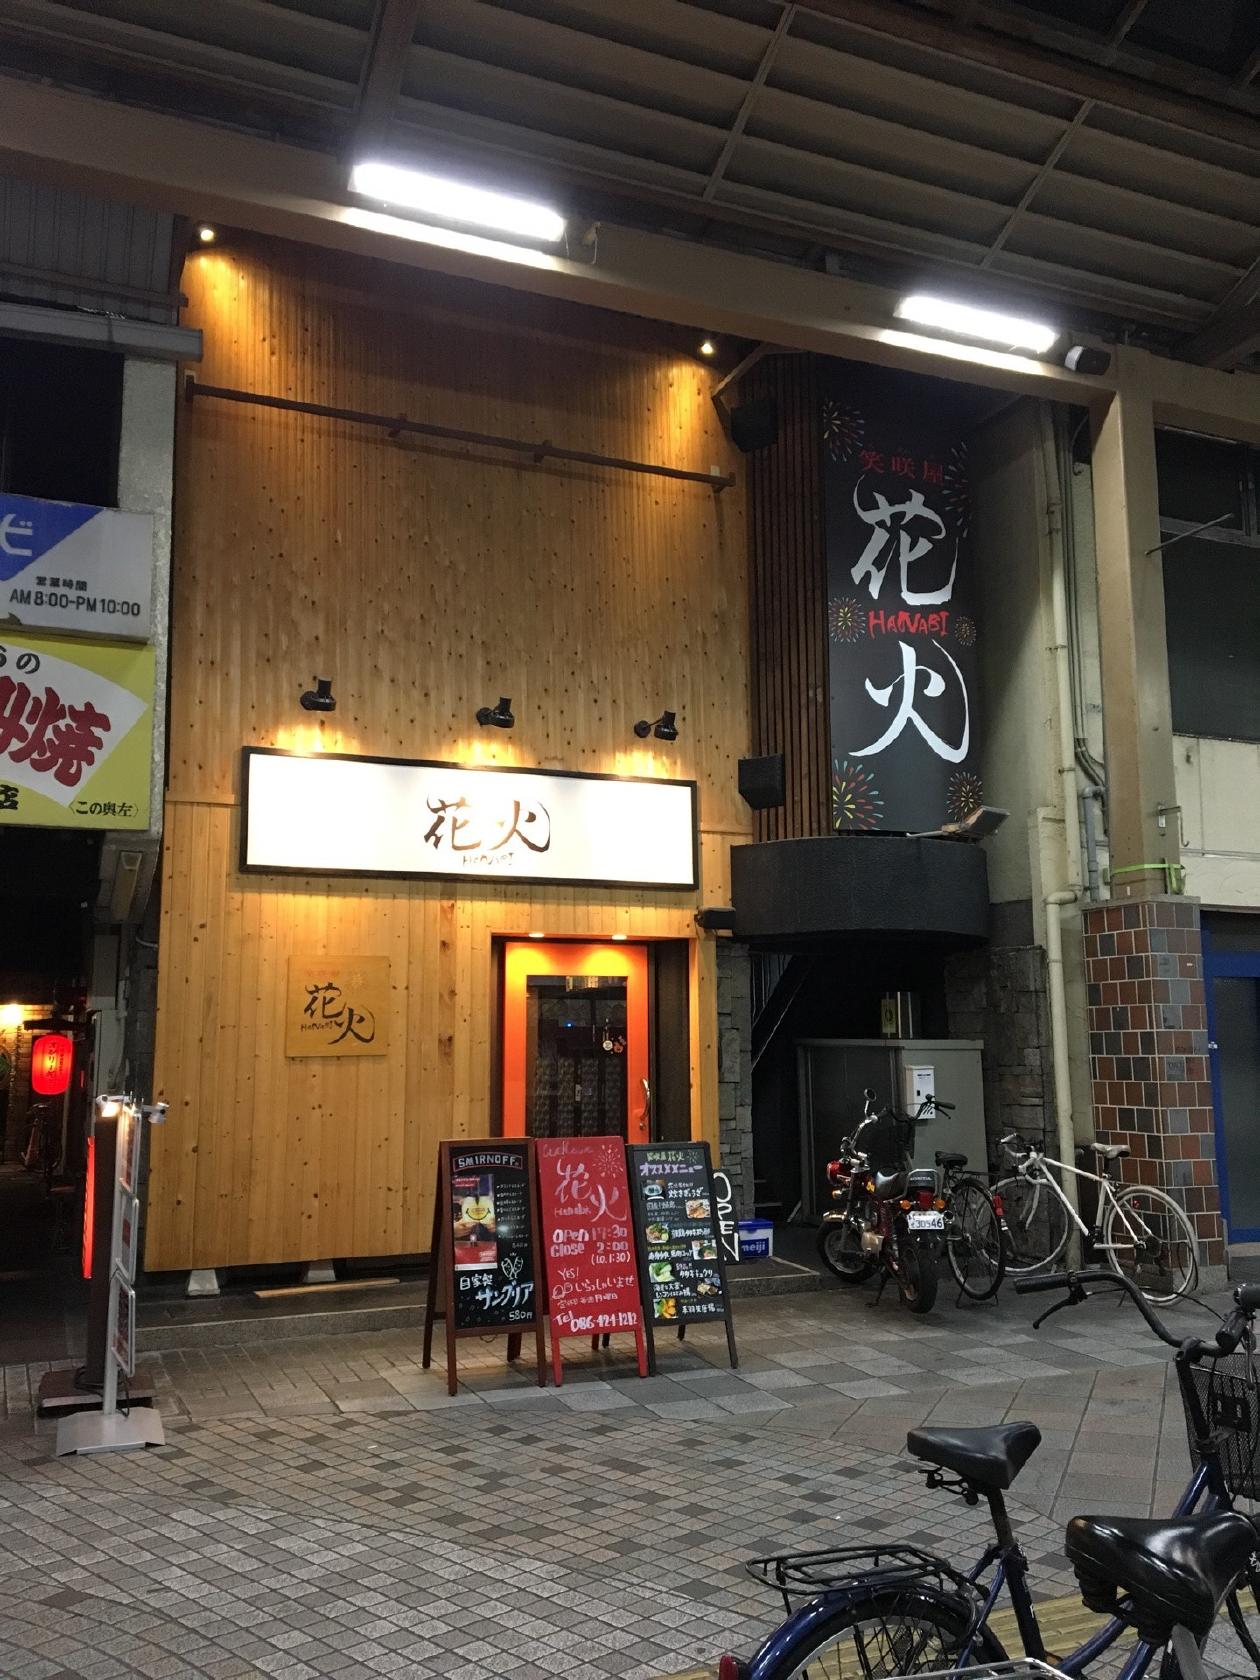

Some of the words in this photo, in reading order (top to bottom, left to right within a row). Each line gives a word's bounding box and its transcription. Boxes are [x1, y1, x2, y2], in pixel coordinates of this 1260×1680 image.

[36, 575, 88, 592] 営業時間
[424, 793, 551, 853] 花火
[458, 1154, 517, 1168] SMIRNOFF
[475, 1280, 535, 1310] サングリア
